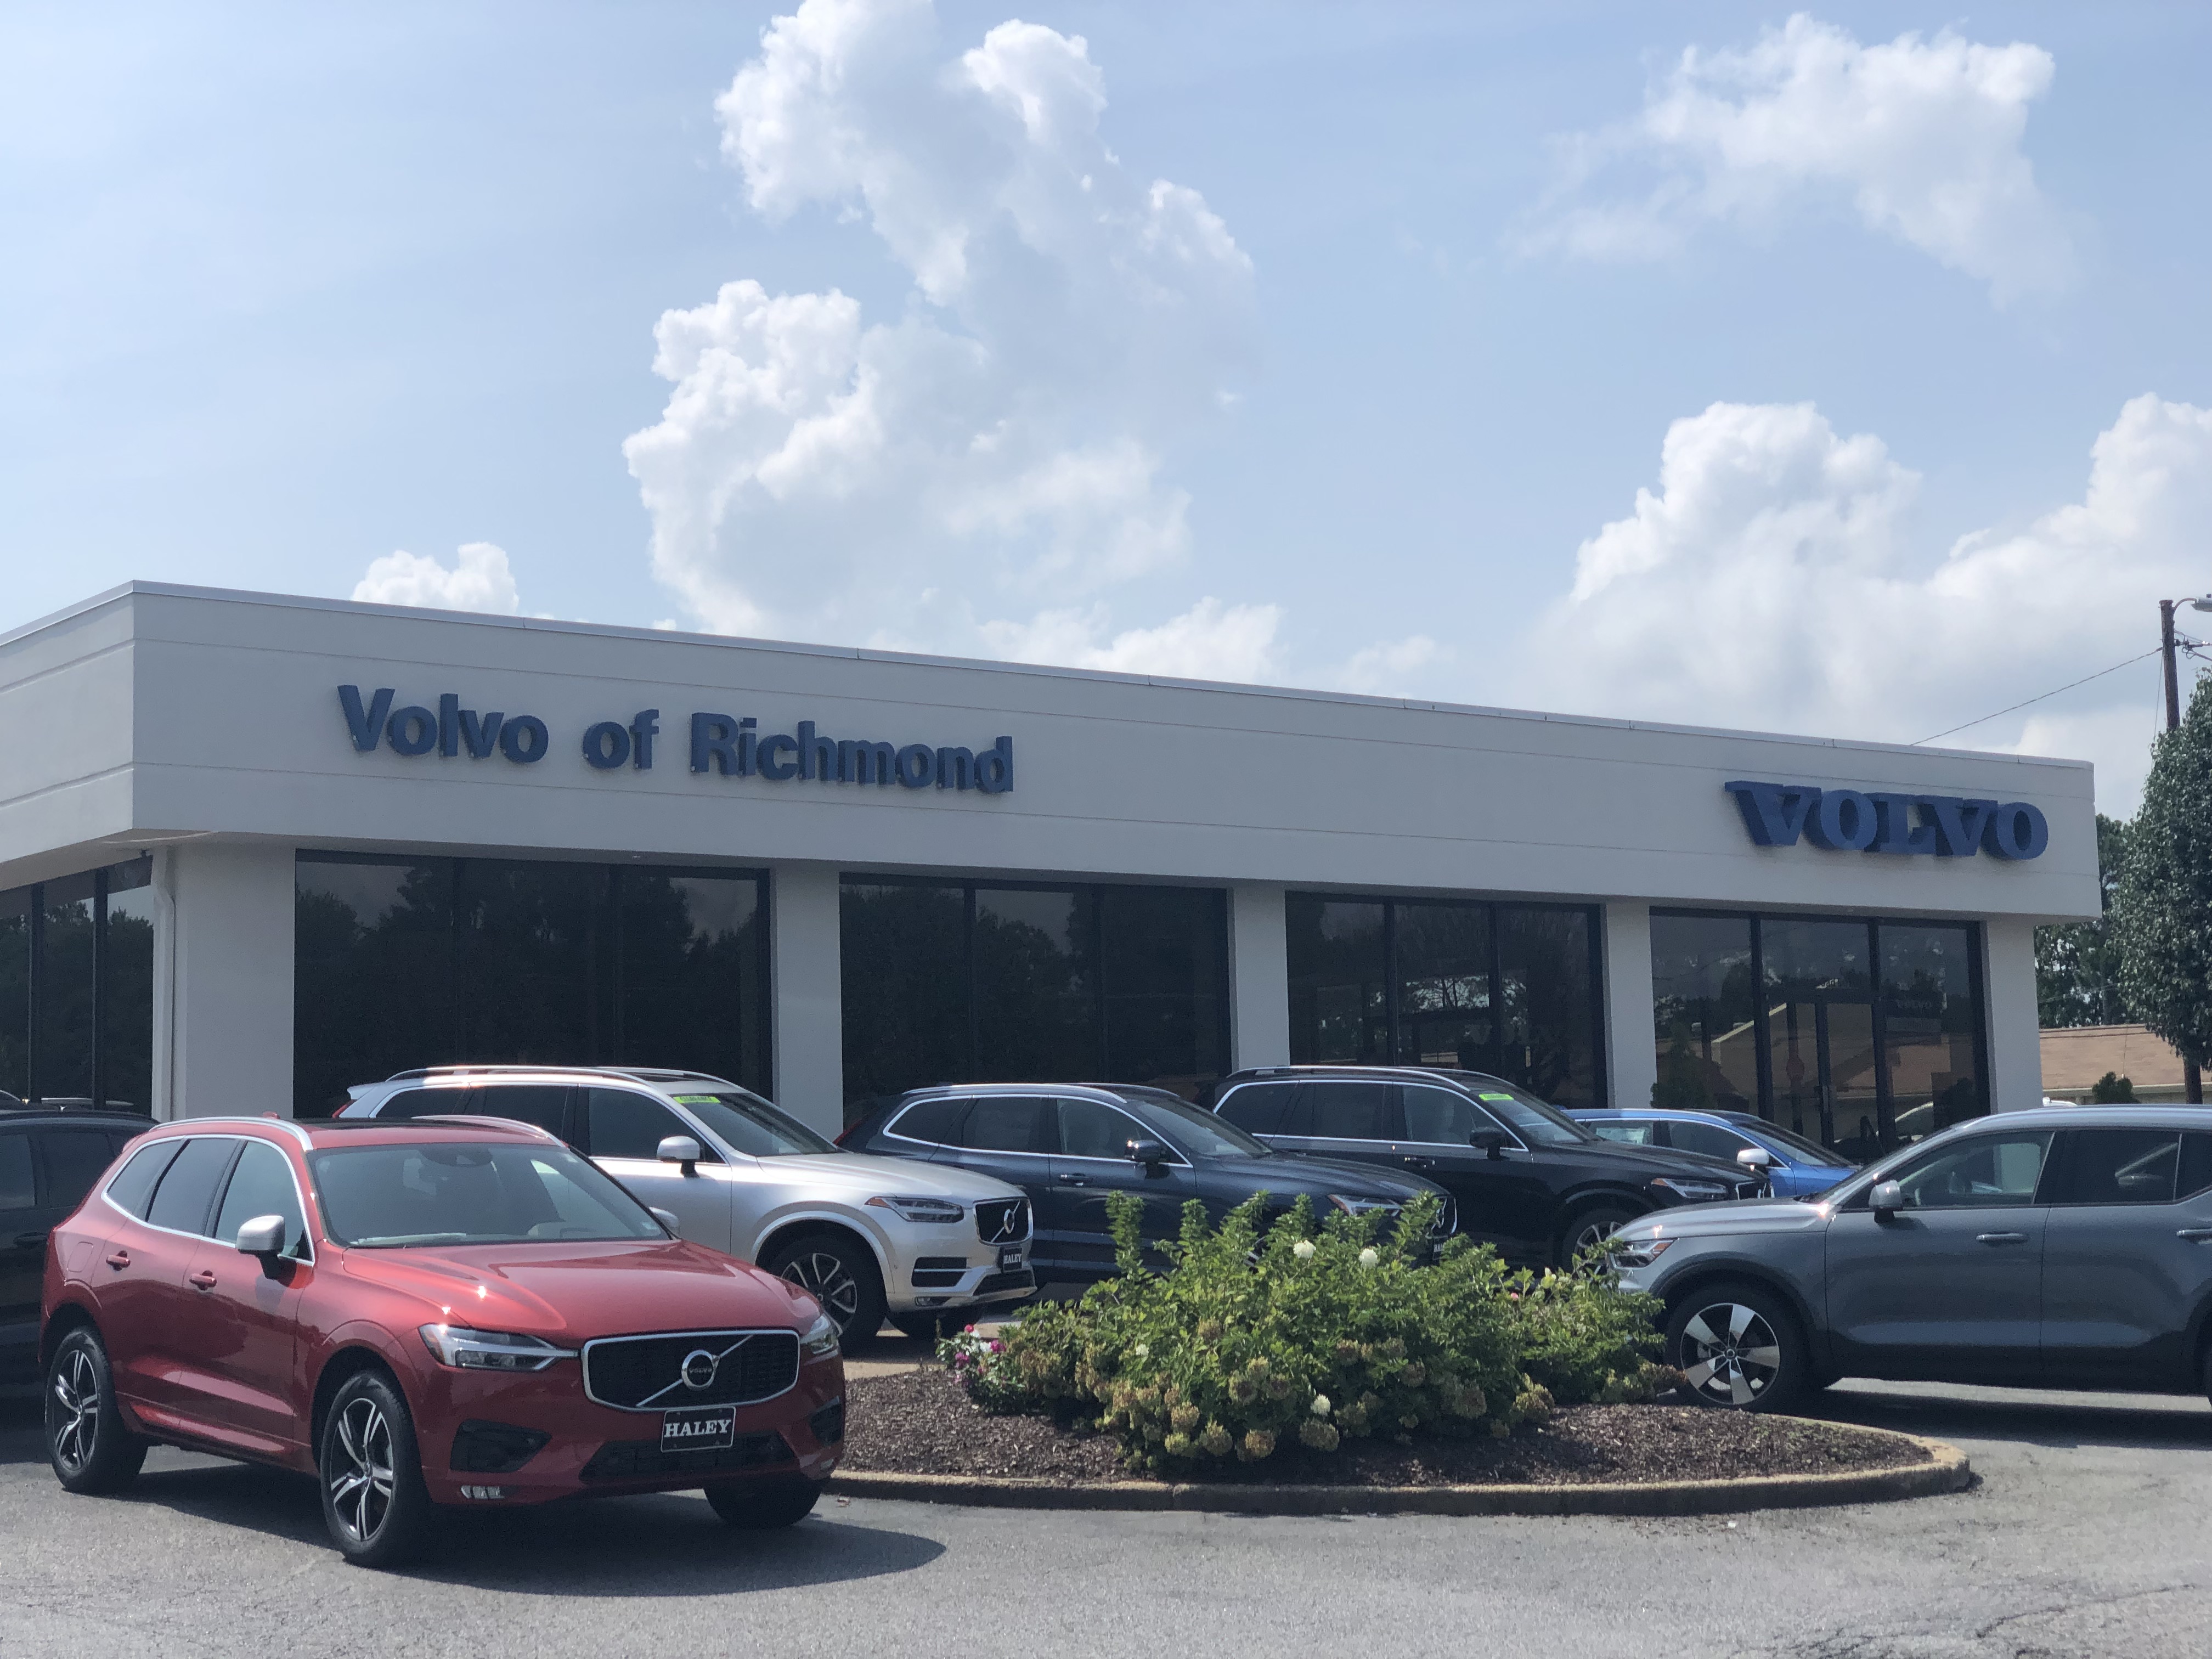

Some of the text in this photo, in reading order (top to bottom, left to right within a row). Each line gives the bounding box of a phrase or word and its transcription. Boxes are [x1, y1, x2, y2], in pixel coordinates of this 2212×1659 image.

[337, 684, 1014, 793] Volvo of Richmond
[1724, 780, 2049, 860] VOLVO
[1003, 1254, 1022, 1264] HALEY
[664, 1419, 731, 1437] HALEY
